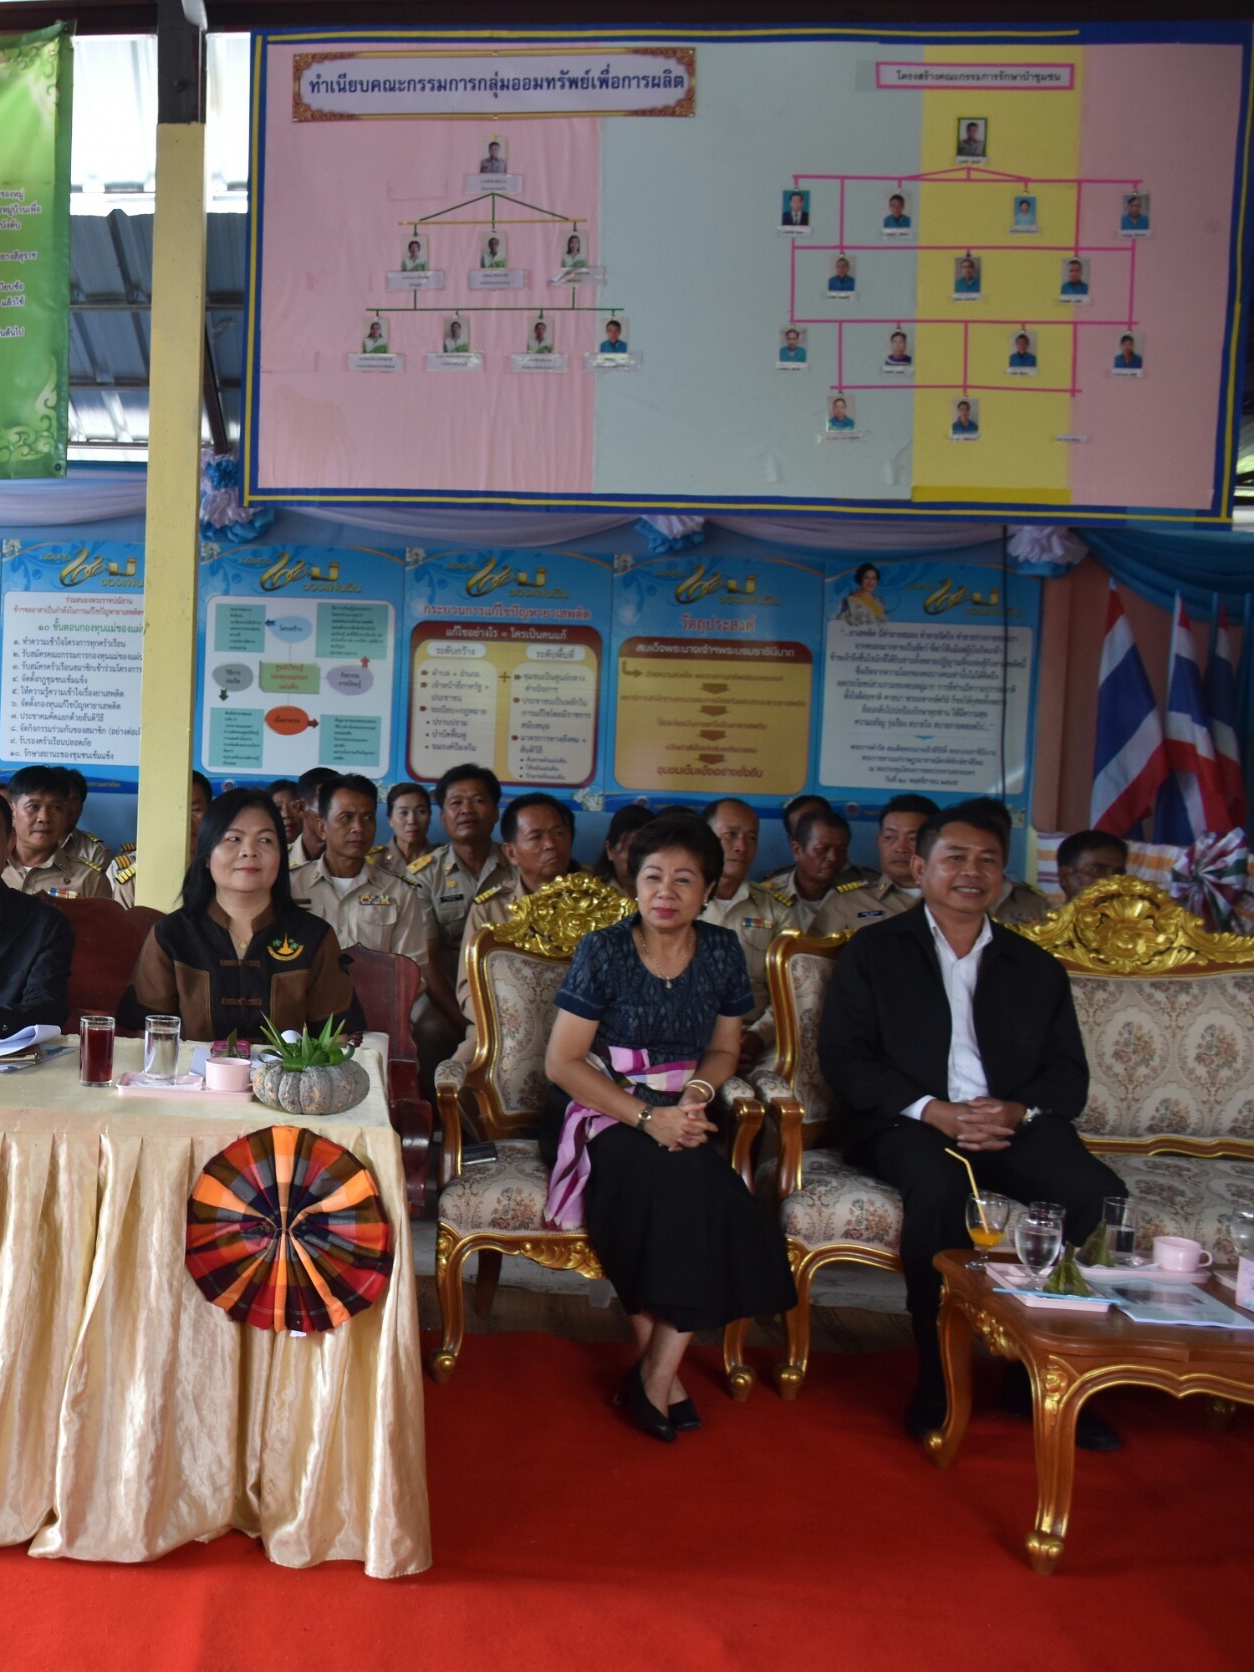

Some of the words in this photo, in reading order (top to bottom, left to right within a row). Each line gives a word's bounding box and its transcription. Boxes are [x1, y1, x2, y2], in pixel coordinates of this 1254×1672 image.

[100, 578, 144, 588] ของแผ่
[680, 614, 755, 635] วัตถุประสงค์
